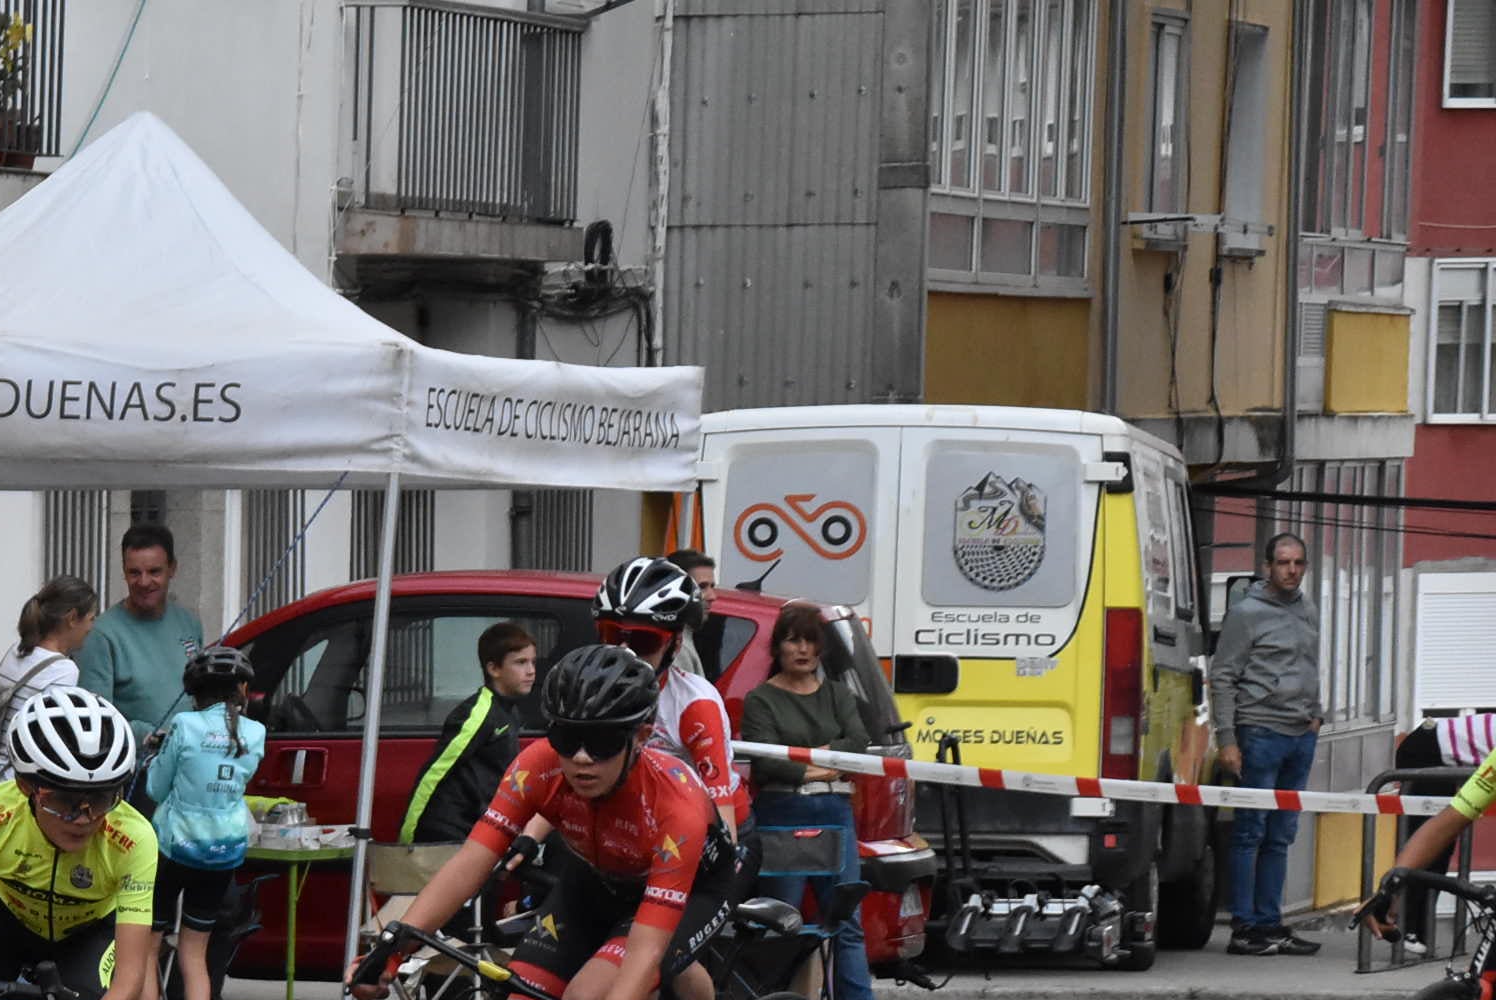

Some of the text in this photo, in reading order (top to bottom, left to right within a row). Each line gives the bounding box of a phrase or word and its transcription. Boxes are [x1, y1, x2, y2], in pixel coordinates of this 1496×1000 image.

[425, 387, 680, 449] ESCUELA DE CICLISMO BEJARANA
[930, 611, 1042, 624] Escuela de
[914, 628, 1057, 647] Ciclismo
